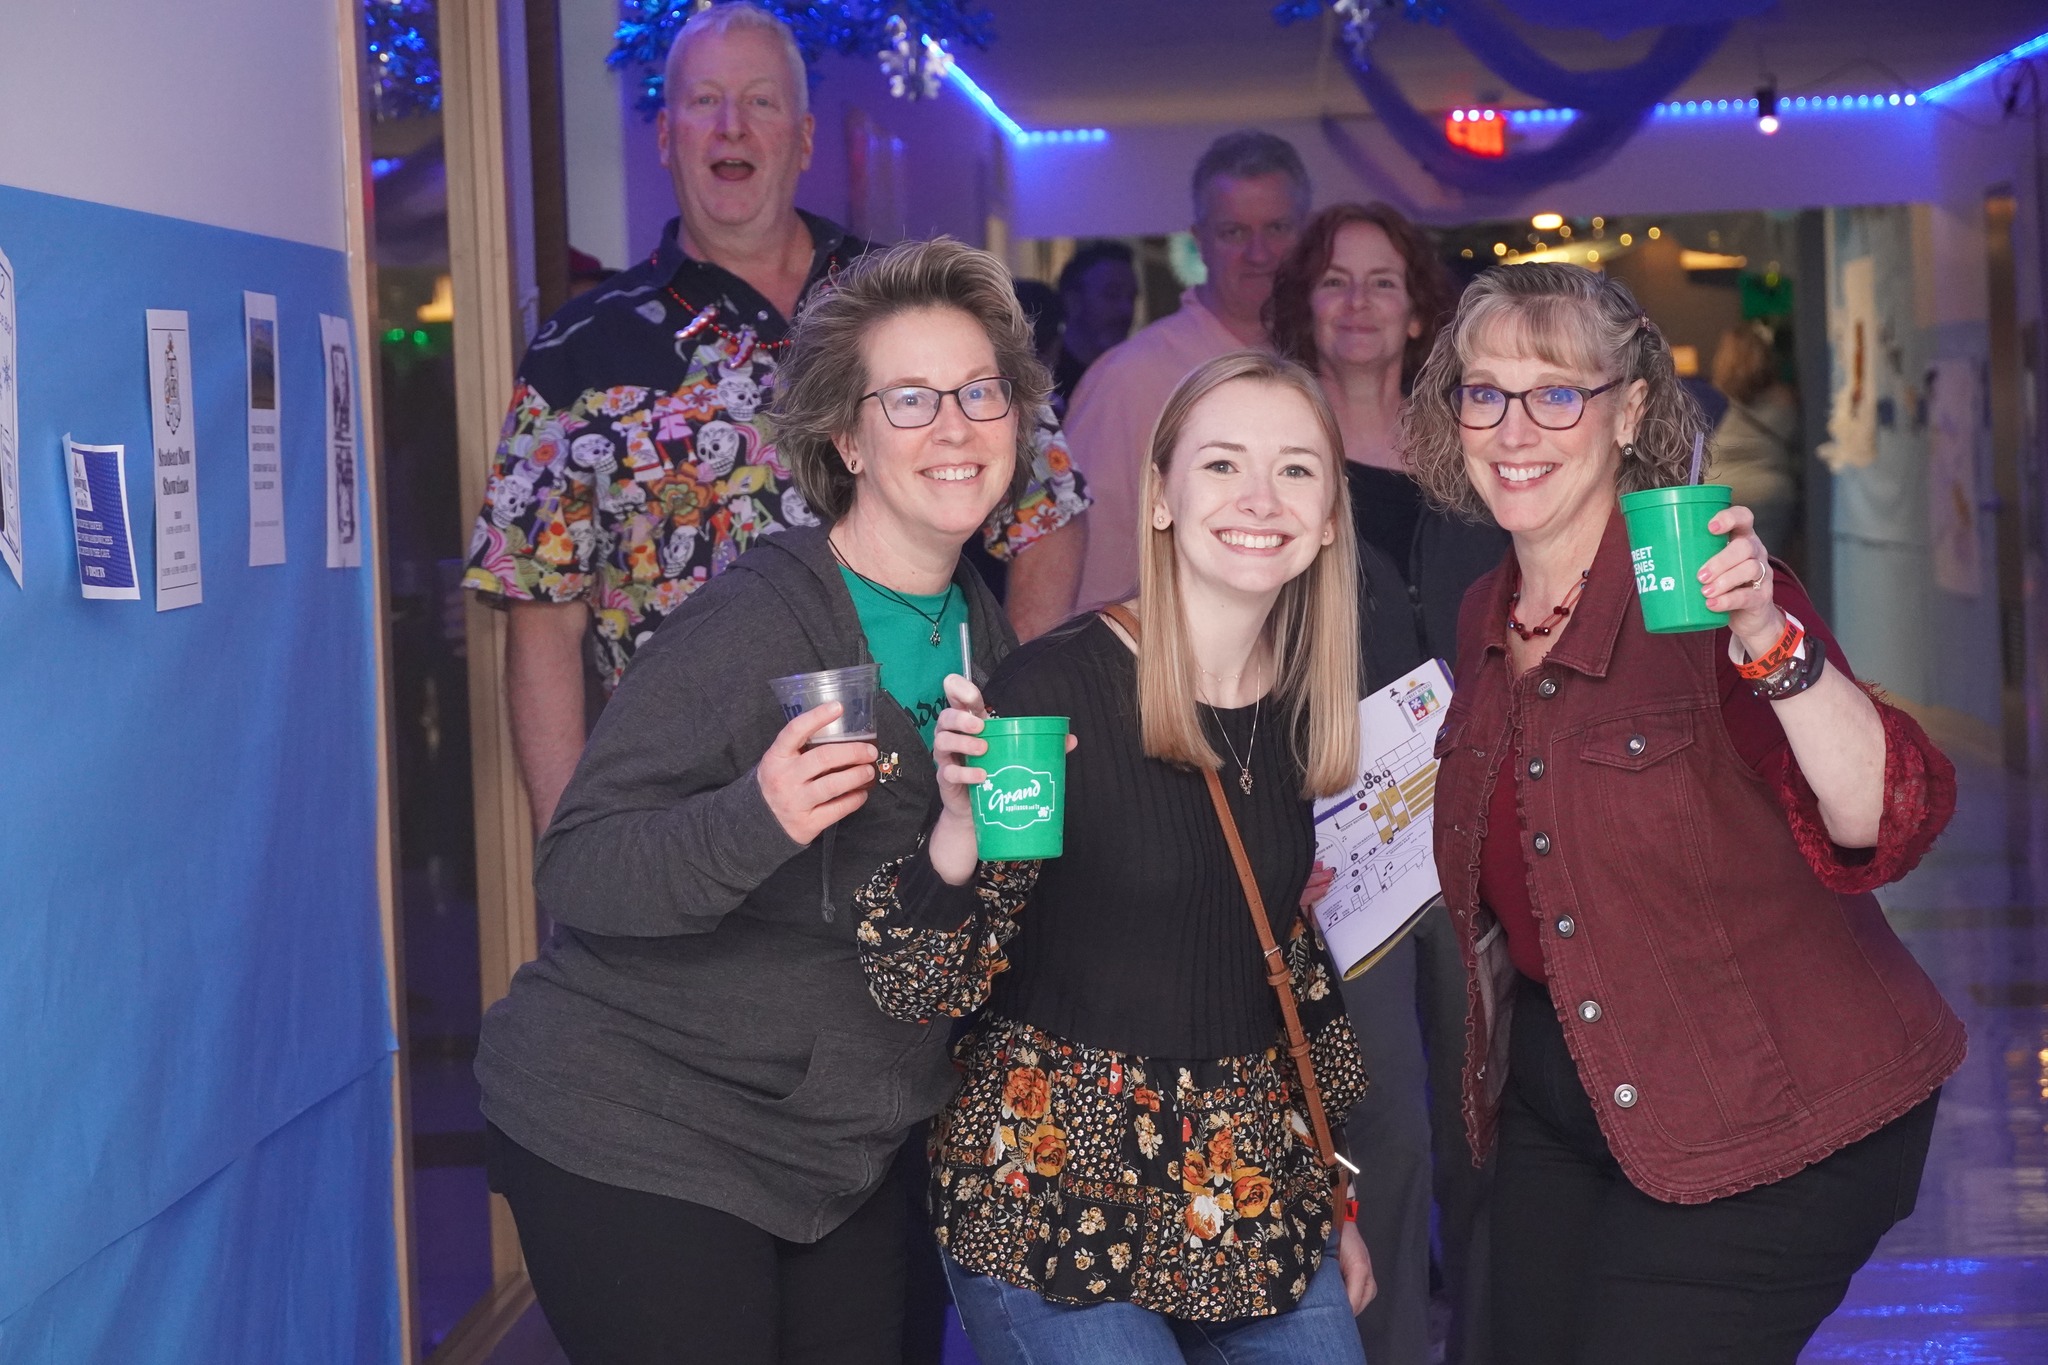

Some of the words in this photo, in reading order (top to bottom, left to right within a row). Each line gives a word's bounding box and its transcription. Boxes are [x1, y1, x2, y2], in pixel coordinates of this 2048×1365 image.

[1781, 624, 1797, 652] OVER
[1758, 646, 1788, 671] 21
[988, 779, 1041, 814] Grand
